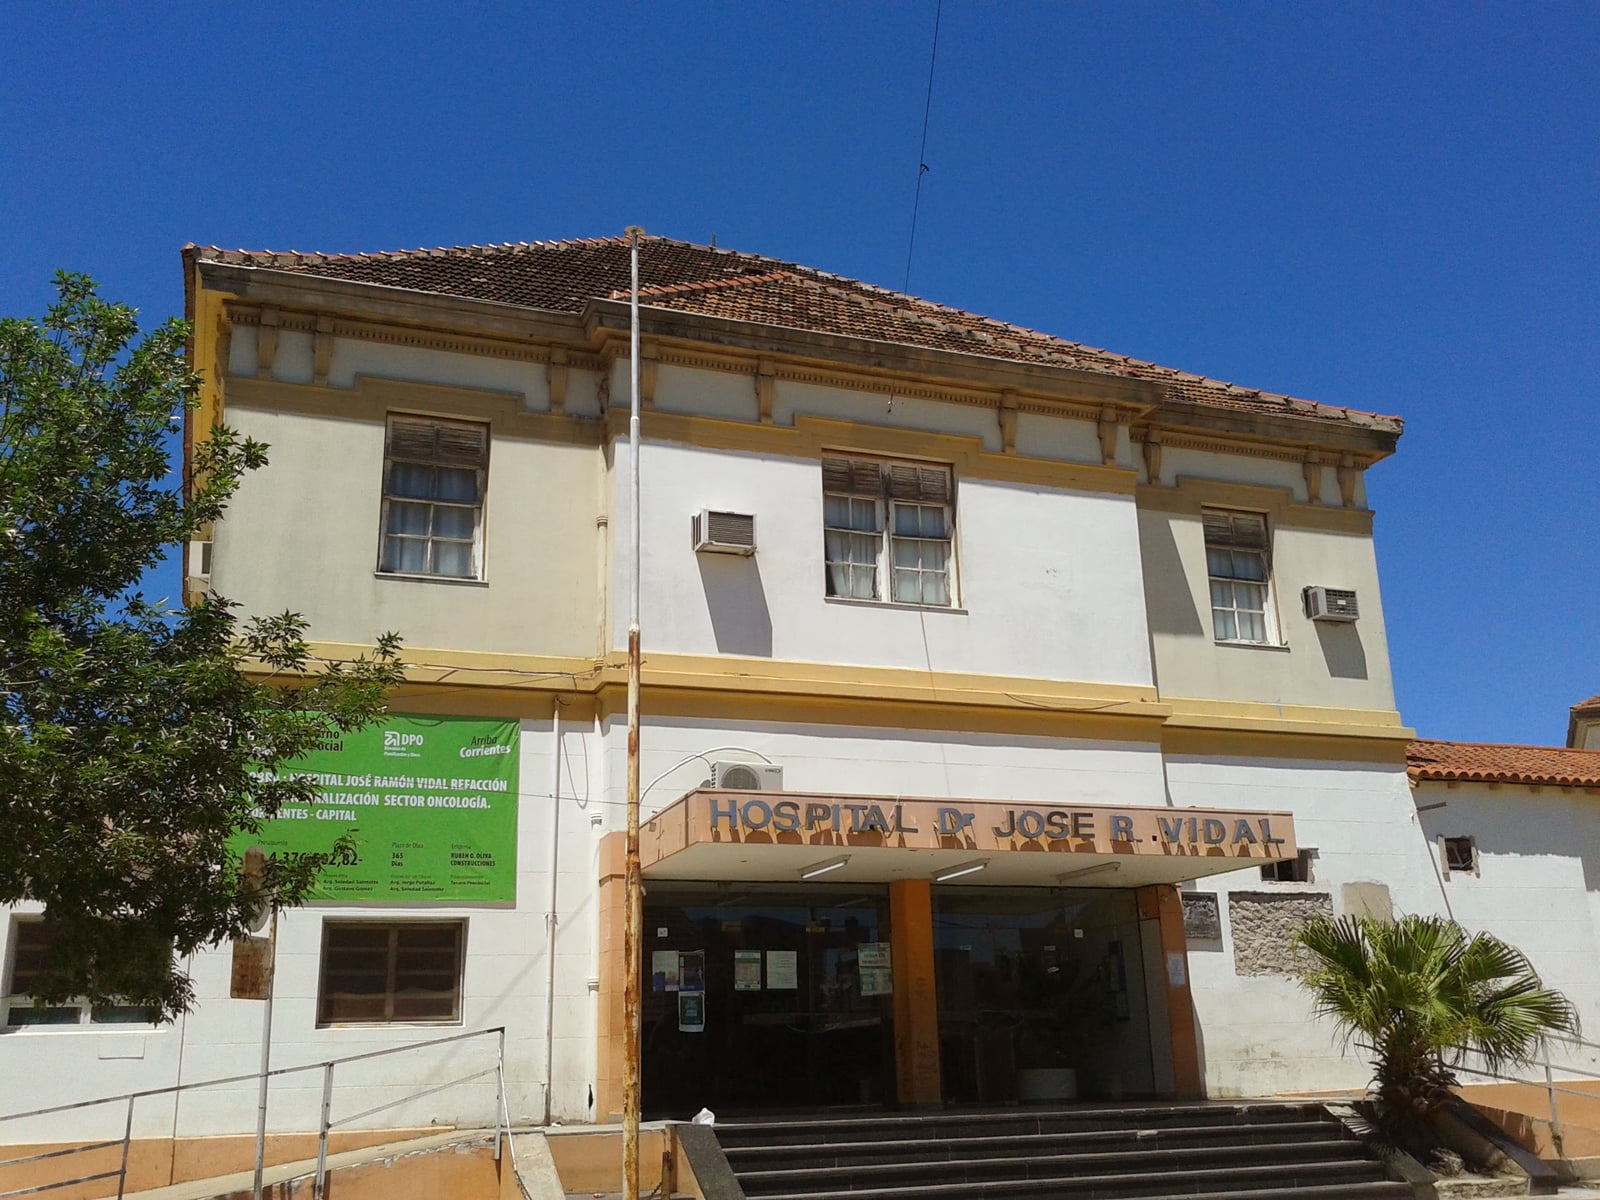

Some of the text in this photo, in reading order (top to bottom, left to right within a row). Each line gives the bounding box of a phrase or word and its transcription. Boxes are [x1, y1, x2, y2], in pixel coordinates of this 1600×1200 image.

[402, 734, 424, 746] DPO
[471, 735, 498, 746] Arriba
[460, 744, 511, 758] Corrientes
[346, 773, 372, 787] JOSÉ
[374, 774, 414, 789] RAMÓN
[417, 777, 449, 790] VIDAL
[451, 778, 508, 792] REFACCIÓN
[384, 795, 425, 807] SECTOR
[427, 795, 491, 809] ONCOLOGÍA.
[315, 810, 357, 821] CAPITAL
[710, 798, 919, 834] HOSPITAL
[938, 807, 976, 835] Dr
[992, 809, 1096, 839] JOSE
[1157, 815, 1286, 845] VIDAL
[391, 852, 404, 860] 365
